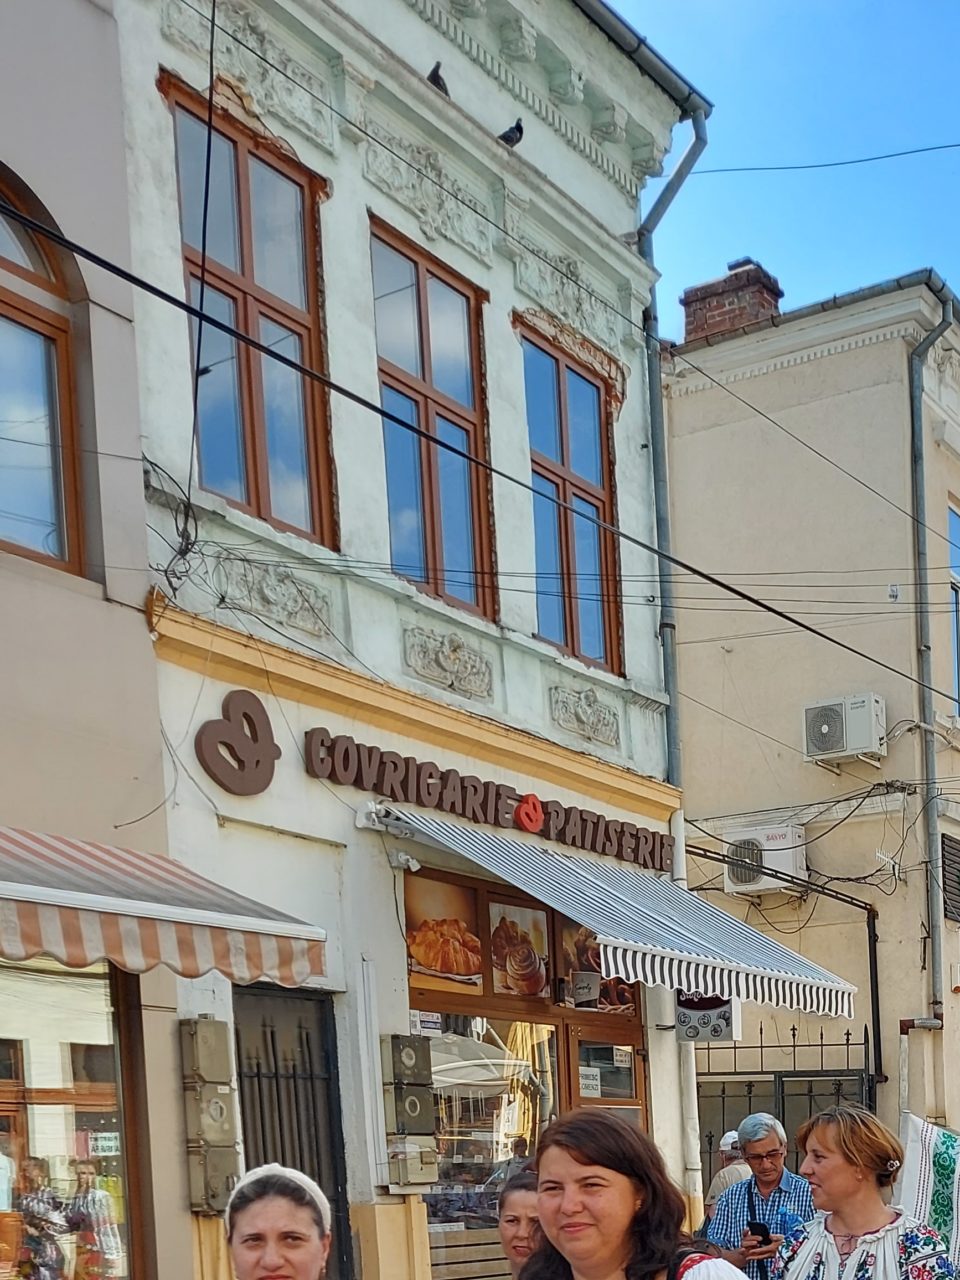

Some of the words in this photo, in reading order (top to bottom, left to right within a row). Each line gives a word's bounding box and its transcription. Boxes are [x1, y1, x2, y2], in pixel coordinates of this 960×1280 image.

[304, 726, 522, 831] COVRIGARIE
[545, 799, 676, 873] PATISERIE
[766, 833, 787, 842] SANYO
